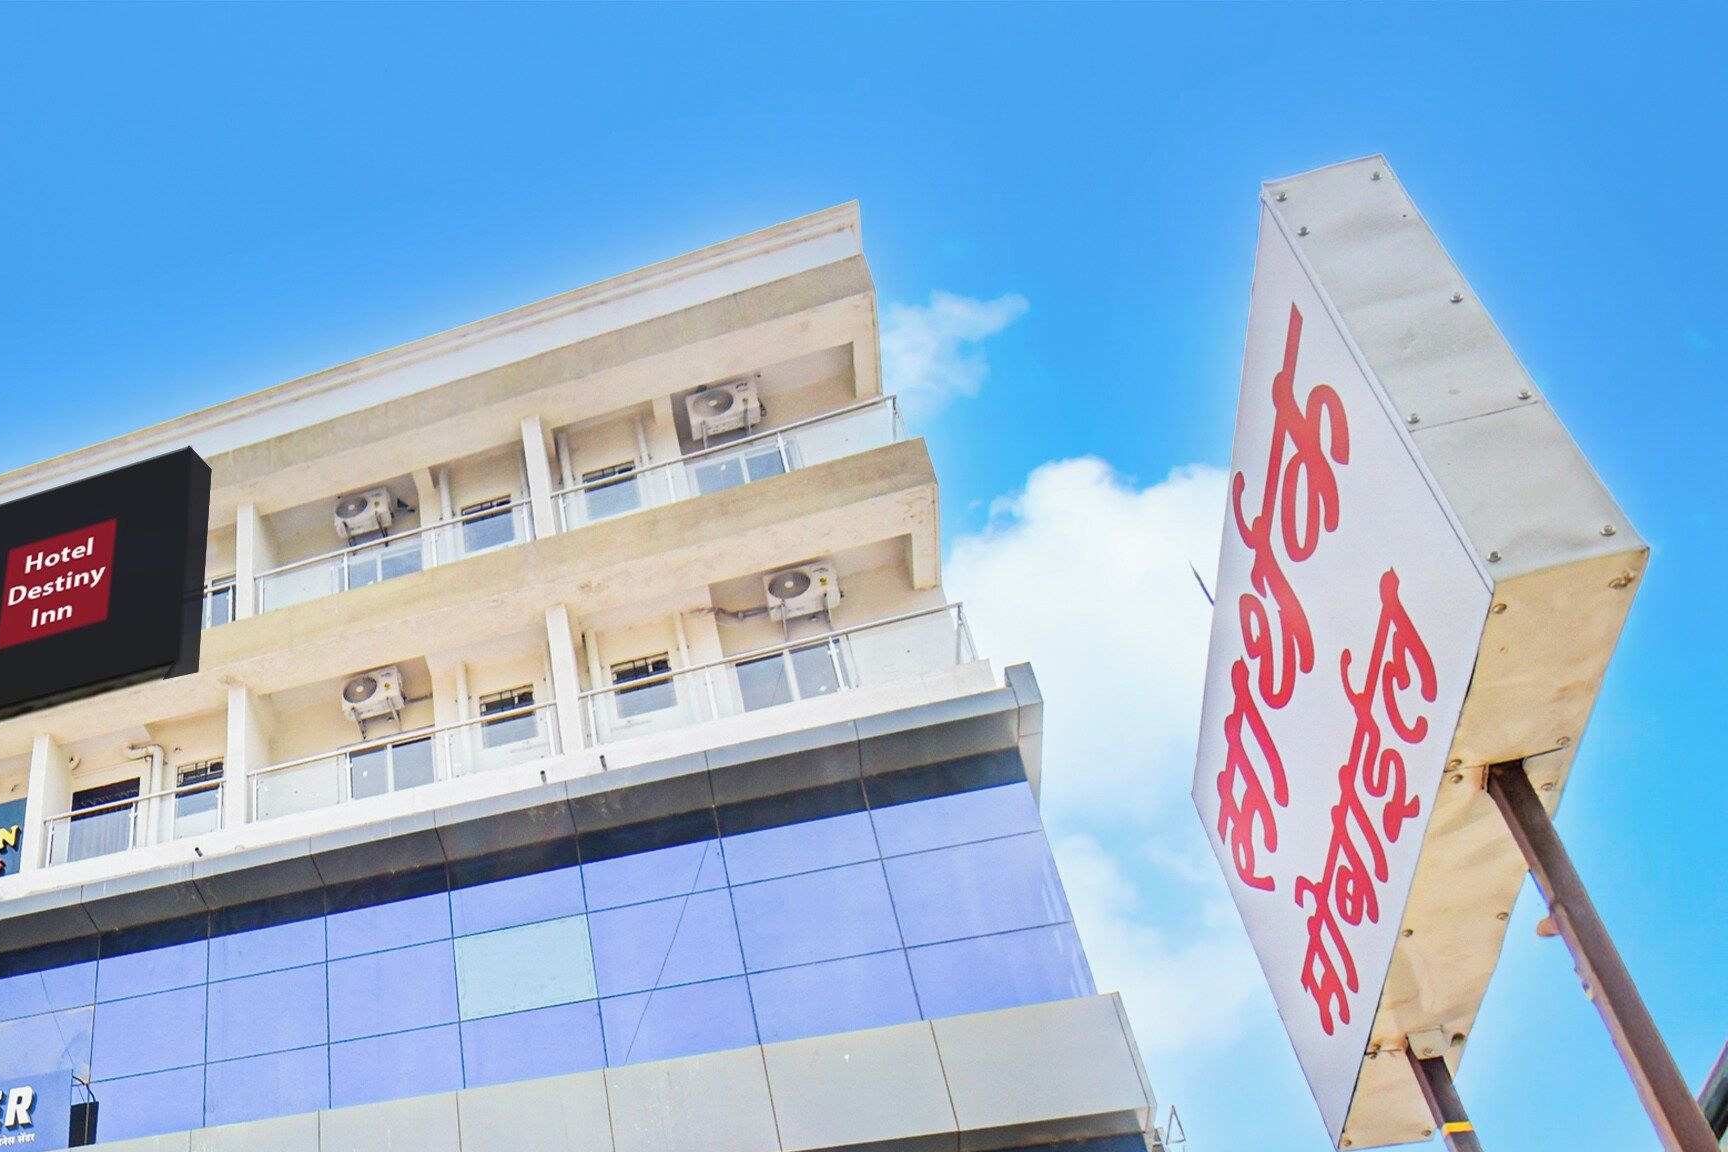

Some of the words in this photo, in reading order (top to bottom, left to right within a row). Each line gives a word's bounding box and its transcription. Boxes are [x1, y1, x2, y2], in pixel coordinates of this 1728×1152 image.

[24, 537, 94, 574] Hotel
[7, 566, 106, 607] Destiny
[1218, 302, 1350, 892] सार्थक
[31, 602, 73, 629] Inn
[1295, 566, 1437, 1036] मोबाईल
